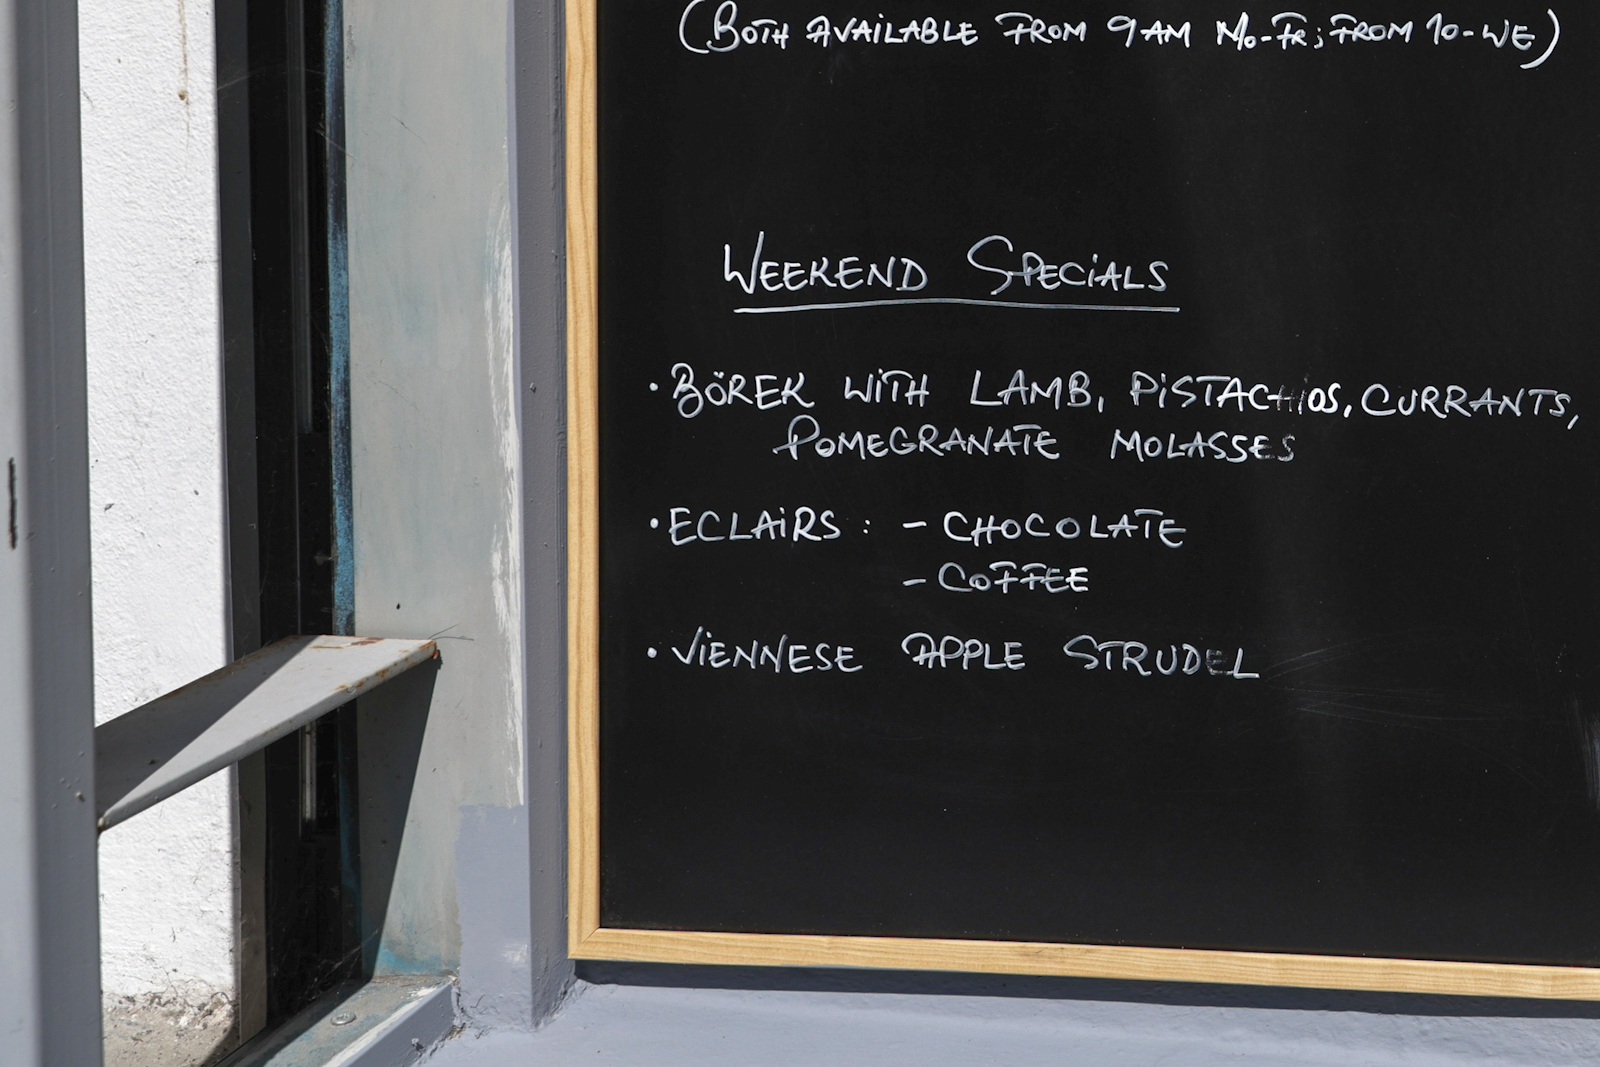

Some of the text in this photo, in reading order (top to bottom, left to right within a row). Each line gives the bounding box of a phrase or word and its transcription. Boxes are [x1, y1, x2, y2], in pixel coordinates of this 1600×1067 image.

[995, 11, 1088, 46] FROM
[723, 231, 929, 295] WEEKEND
[772, 414, 1296, 464] POMEGRANATE MOLASSES
[901, 631, 1027, 672] APPLE
[1063, 633, 1261, 680] STRUDEL
